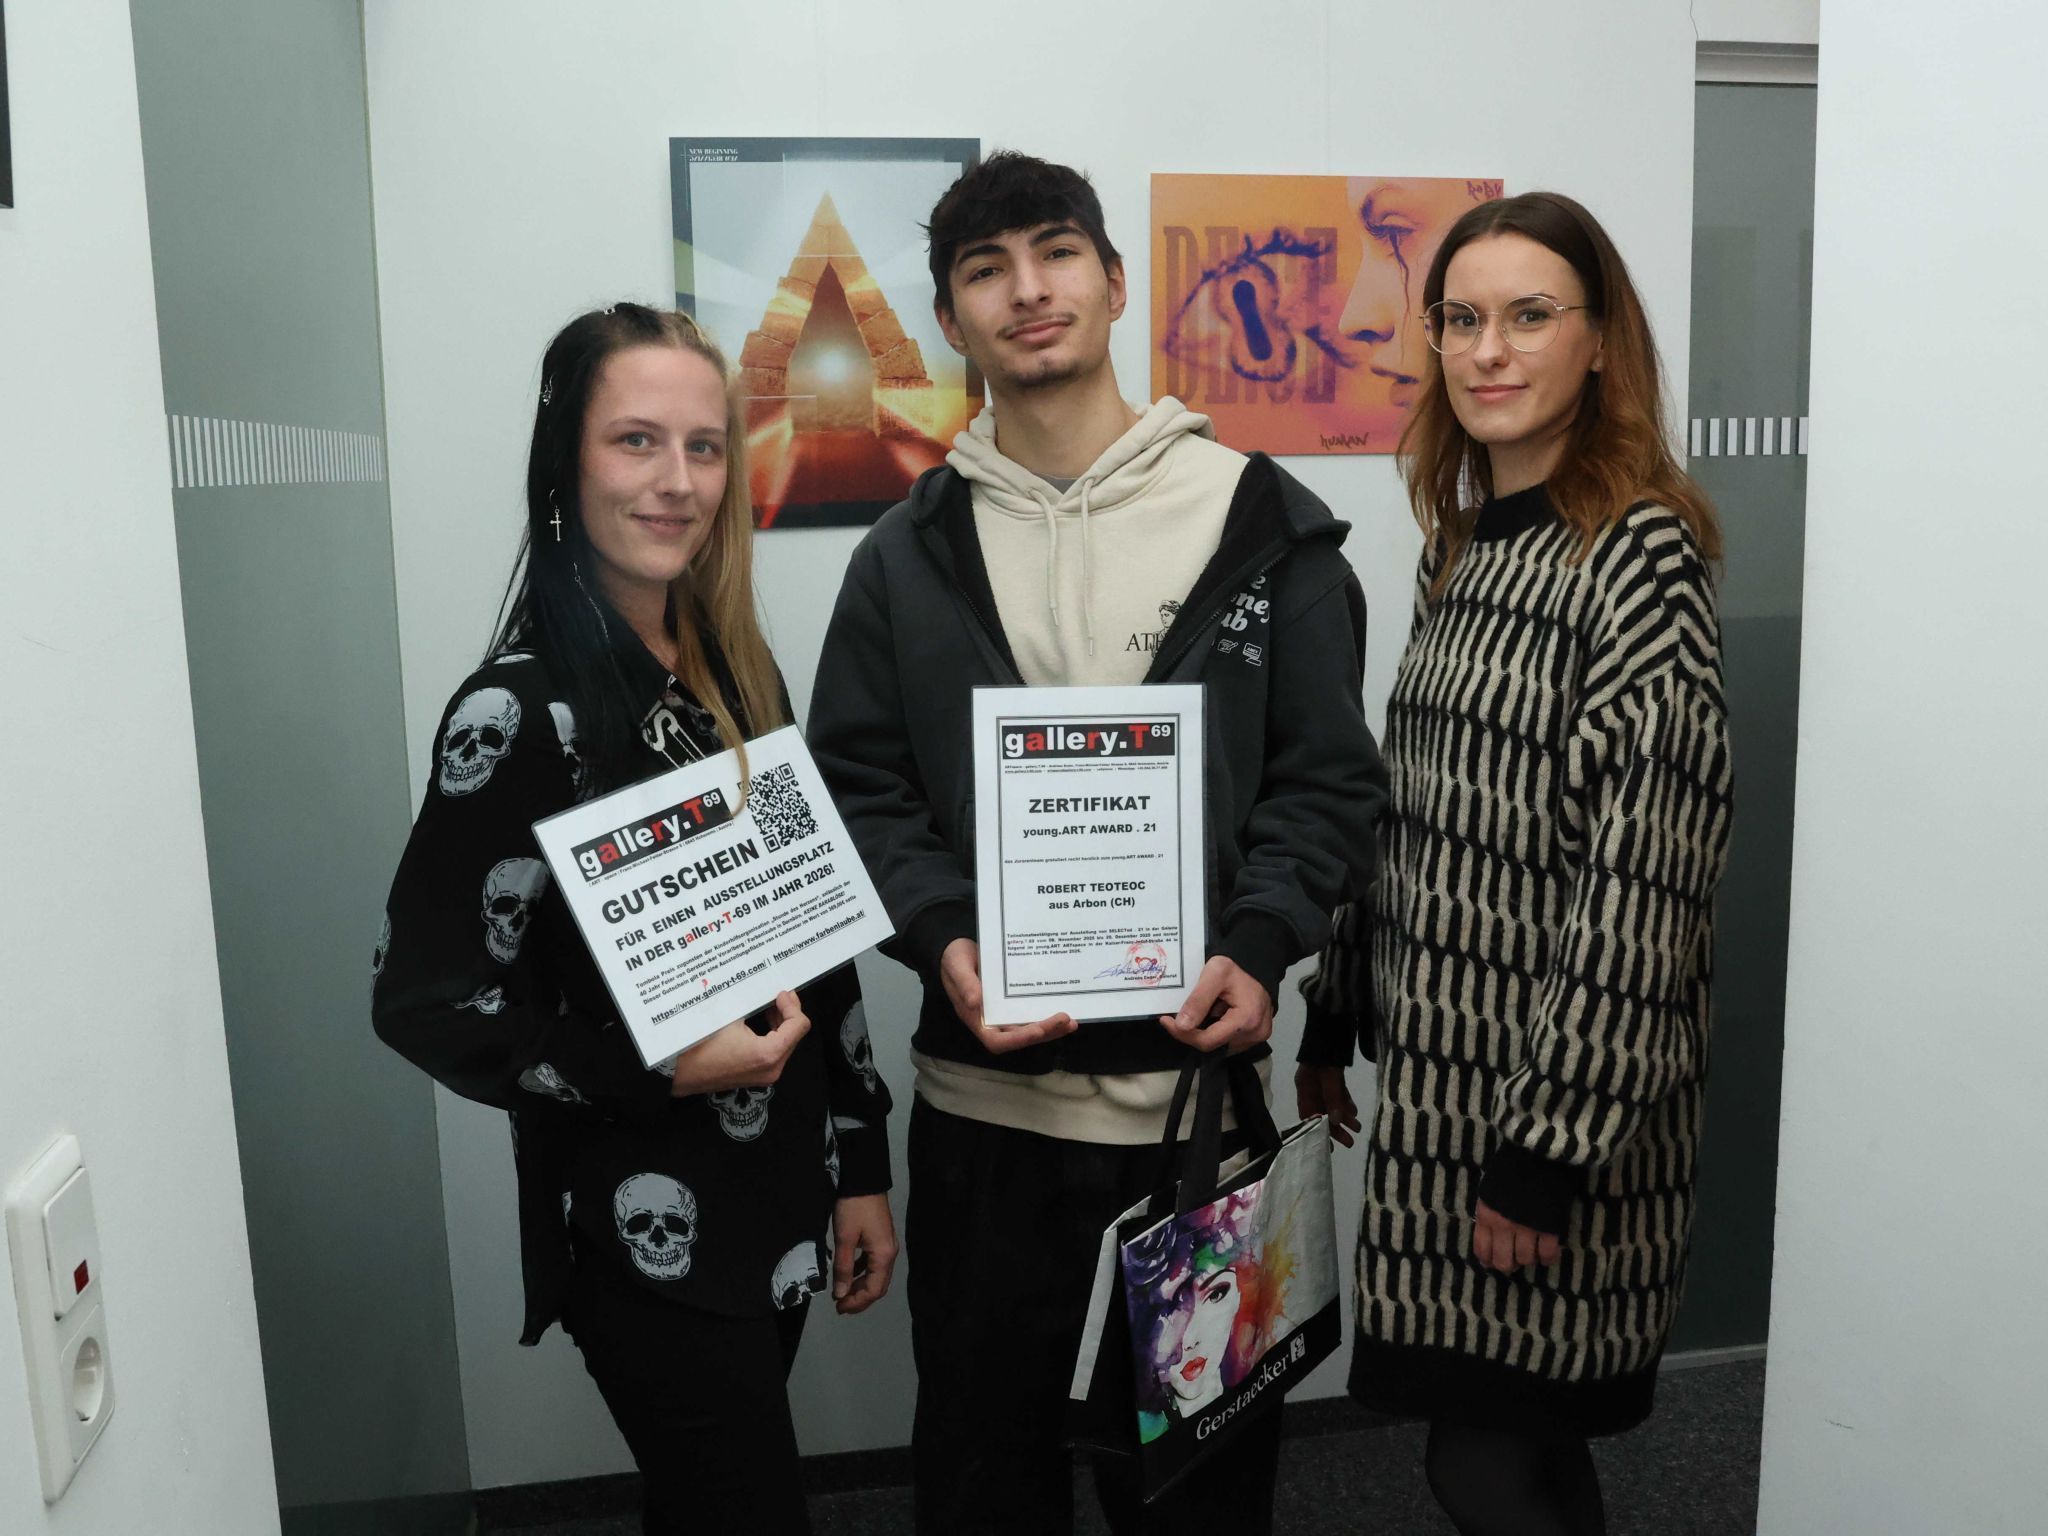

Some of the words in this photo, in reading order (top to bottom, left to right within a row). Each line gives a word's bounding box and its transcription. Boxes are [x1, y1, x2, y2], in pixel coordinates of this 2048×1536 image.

[1028, 795, 1150, 813] ZERTIFIKAT
[1023, 825, 1085, 837] young.ART
[1089, 823, 1132, 833] AWARD
[1143, 822, 1156, 831] 21
[598, 837, 760, 927] GUTSCHEIN
[1037, 883, 1085, 894] ROBERT
[1090, 880, 1145, 892] TEOTEOC
[614, 925, 647, 951] FÜR
[651, 904, 696, 934] EINEN
[700, 840, 834, 911] AUSSTELLUNGSPLATZ
[1048, 900, 1069, 909] aus
[1073, 898, 1106, 908] Arbon
[1110, 896, 1135, 908] (CH)
[624, 954, 643, 971] IN
[643, 939, 675, 962] DER
[674, 902, 753, 950] gallery-T-69
[751, 893, 769, 910] IM
[768, 876, 804, 902] JAHR
[803, 862, 835, 885] 2026!
[647, 982, 661, 993] Jahr
[661, 978, 689, 996] Gutschein
[1196, 1353, 1289, 1440] Gerstaecker
